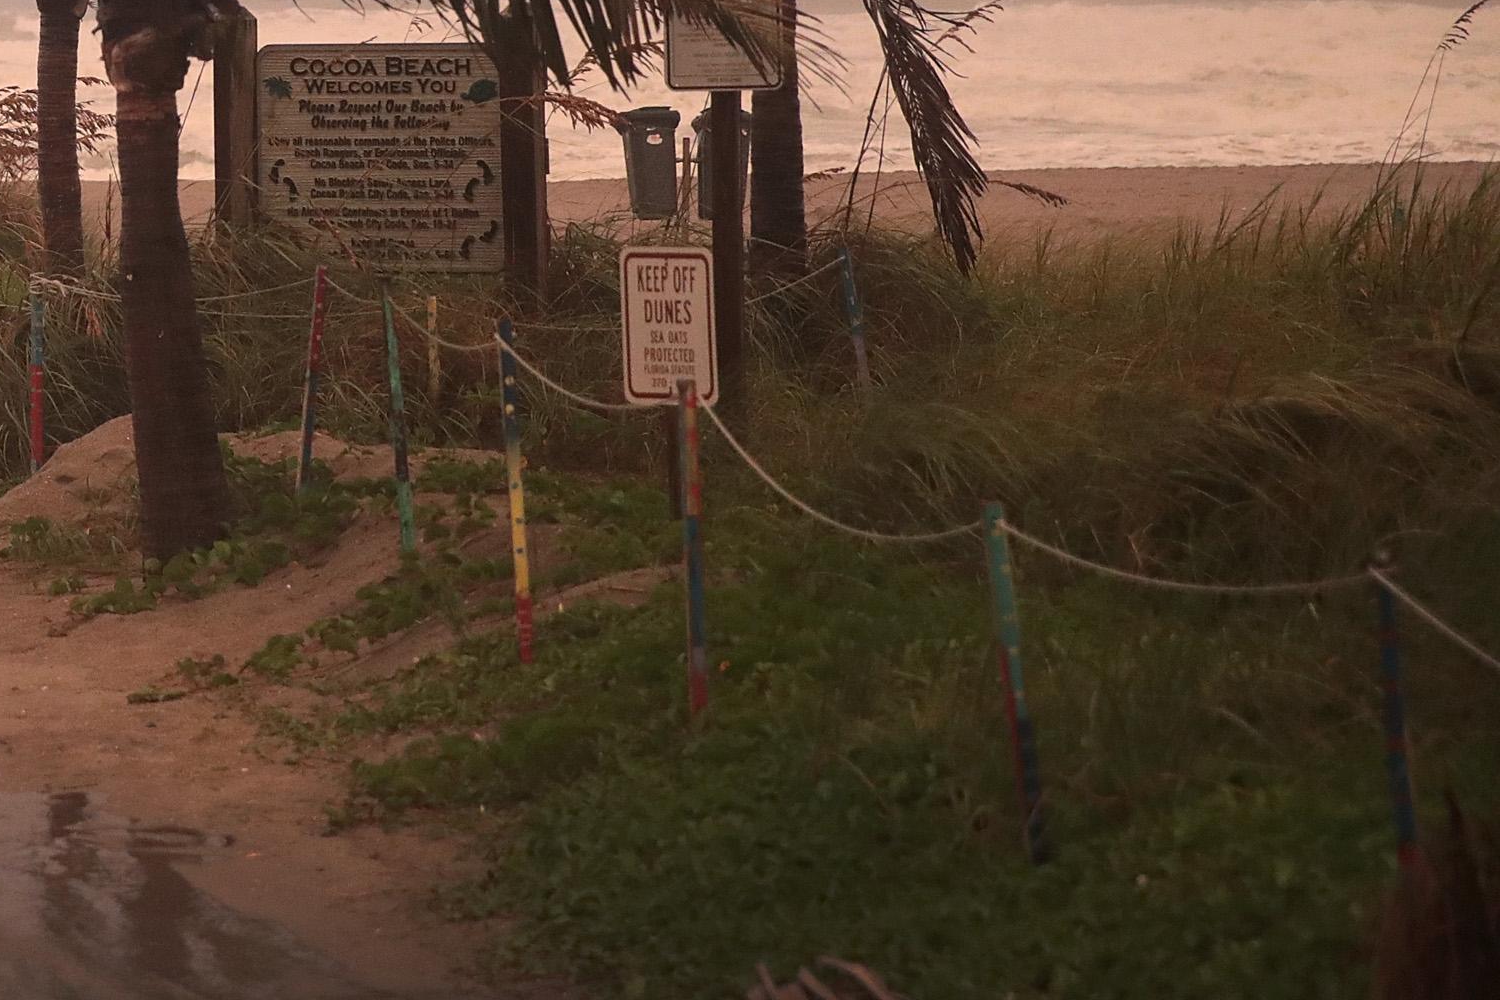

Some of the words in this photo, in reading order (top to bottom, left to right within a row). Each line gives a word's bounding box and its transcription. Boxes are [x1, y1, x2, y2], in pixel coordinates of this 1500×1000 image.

[290, 57, 378, 77] COCOA
[385, 56, 472, 77] BEACH
[304, 78, 412, 95] WELCOMES
[416, 78, 456, 95] YOU
[298, 99, 335, 114] Please
[338, 99, 382, 115] Respect
[385, 99, 407, 113] Our
[411, 100, 447, 114] Beach
[311, 115, 367, 131] Observing
[371, 115, 389, 129] the
[637, 264, 669, 293] KEEP
[673, 266, 696, 293] OFF
[644, 300, 692, 325] DUNES
[650, 331, 665, 344] SEA
[668, 332, 688, 345] OATS
[644, 349, 695, 363] PROTECTED
